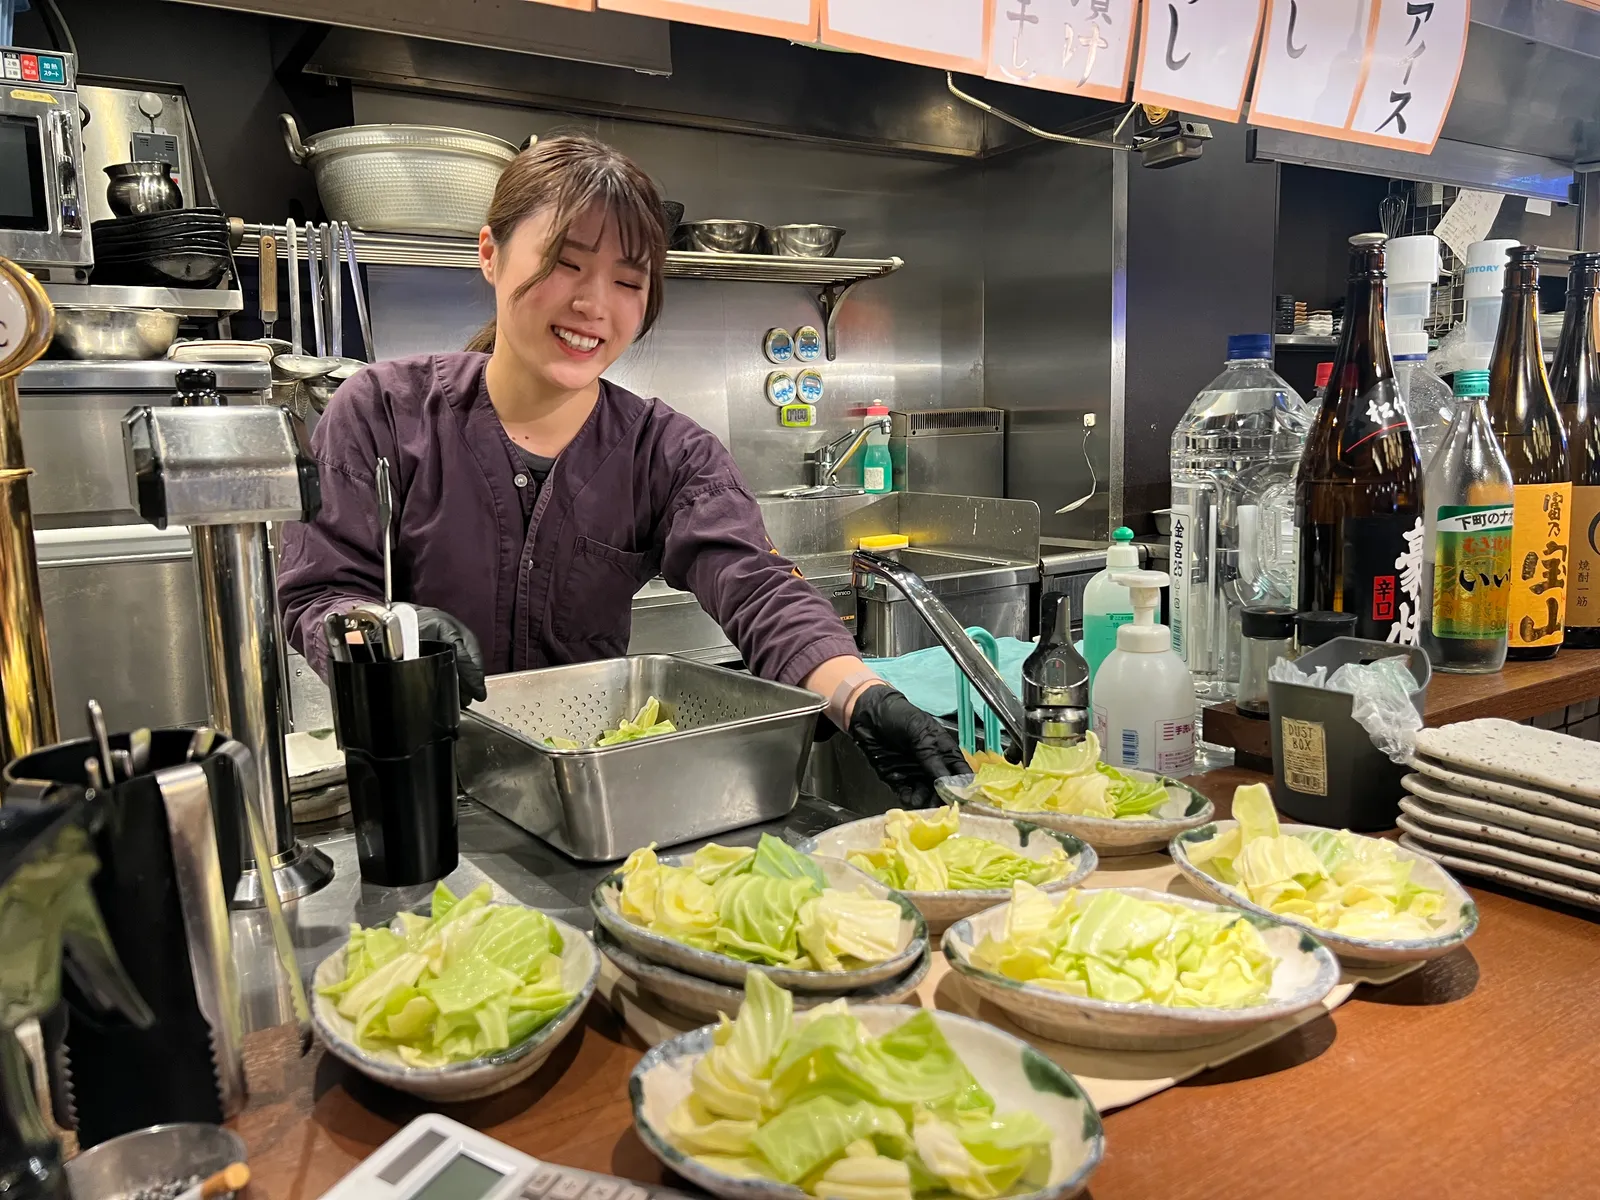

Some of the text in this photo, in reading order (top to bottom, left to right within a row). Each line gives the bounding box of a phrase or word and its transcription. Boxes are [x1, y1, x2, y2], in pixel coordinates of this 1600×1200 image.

[1166, 0, 1199, 71] し
[1374, 2, 1434, 134] アイス
[1464, 265, 1499, 275] UNTORY
[1375, 578, 1394, 617] 辛口
[1576, 559, 1591, 608] 焼酎一筋
[1288, 724, 1314, 739] DUST
[1292, 739, 1312, 752] BOX
